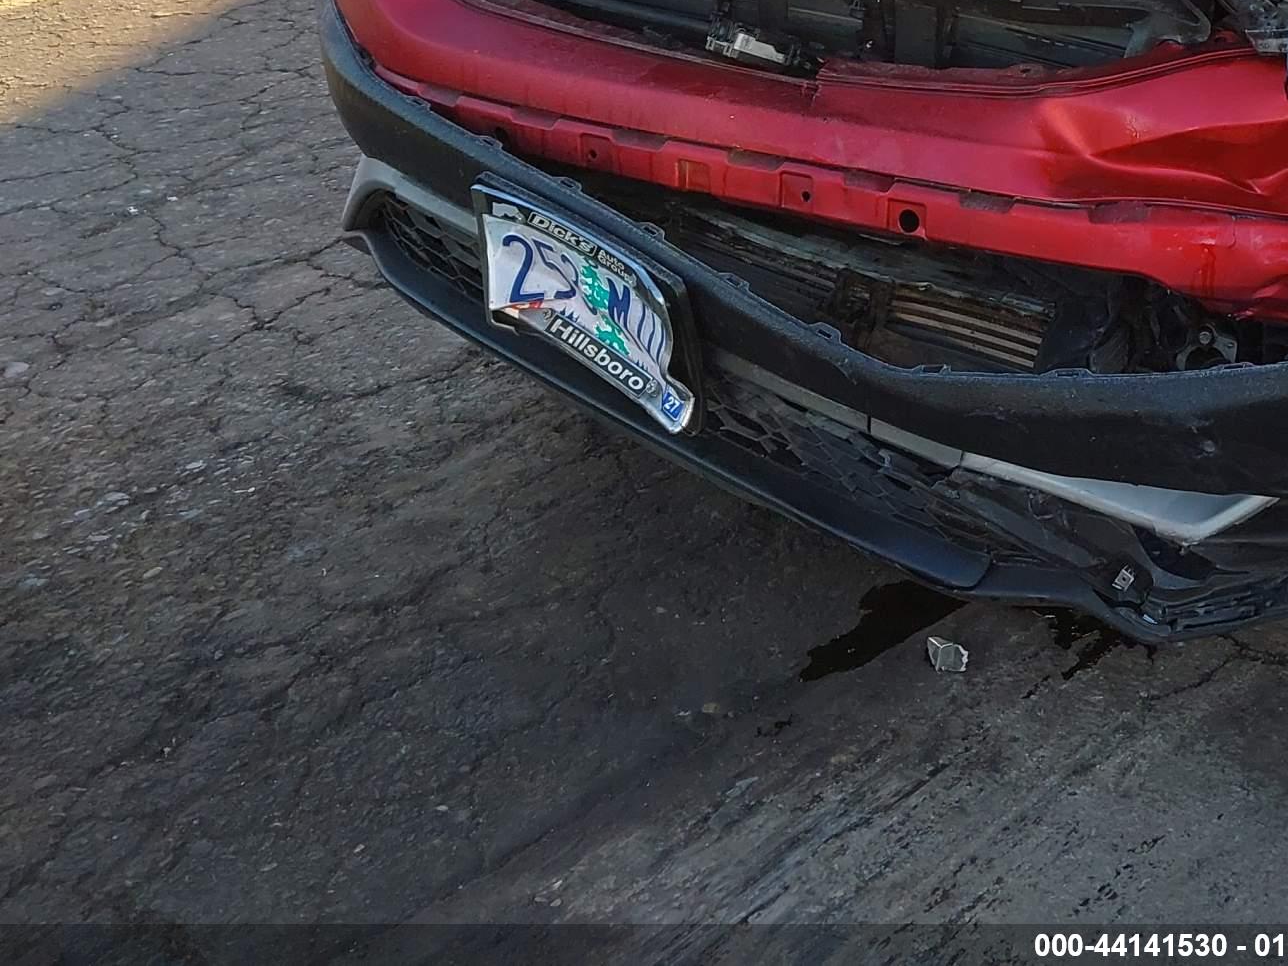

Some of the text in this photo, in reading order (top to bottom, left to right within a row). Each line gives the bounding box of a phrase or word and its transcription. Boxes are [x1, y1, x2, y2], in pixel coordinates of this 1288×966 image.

[532, 215, 594, 252] Dick's
[600, 250, 625, 270] Auto
[550, 319, 644, 392] Hillsboro
[663, 395, 681, 413] 27
